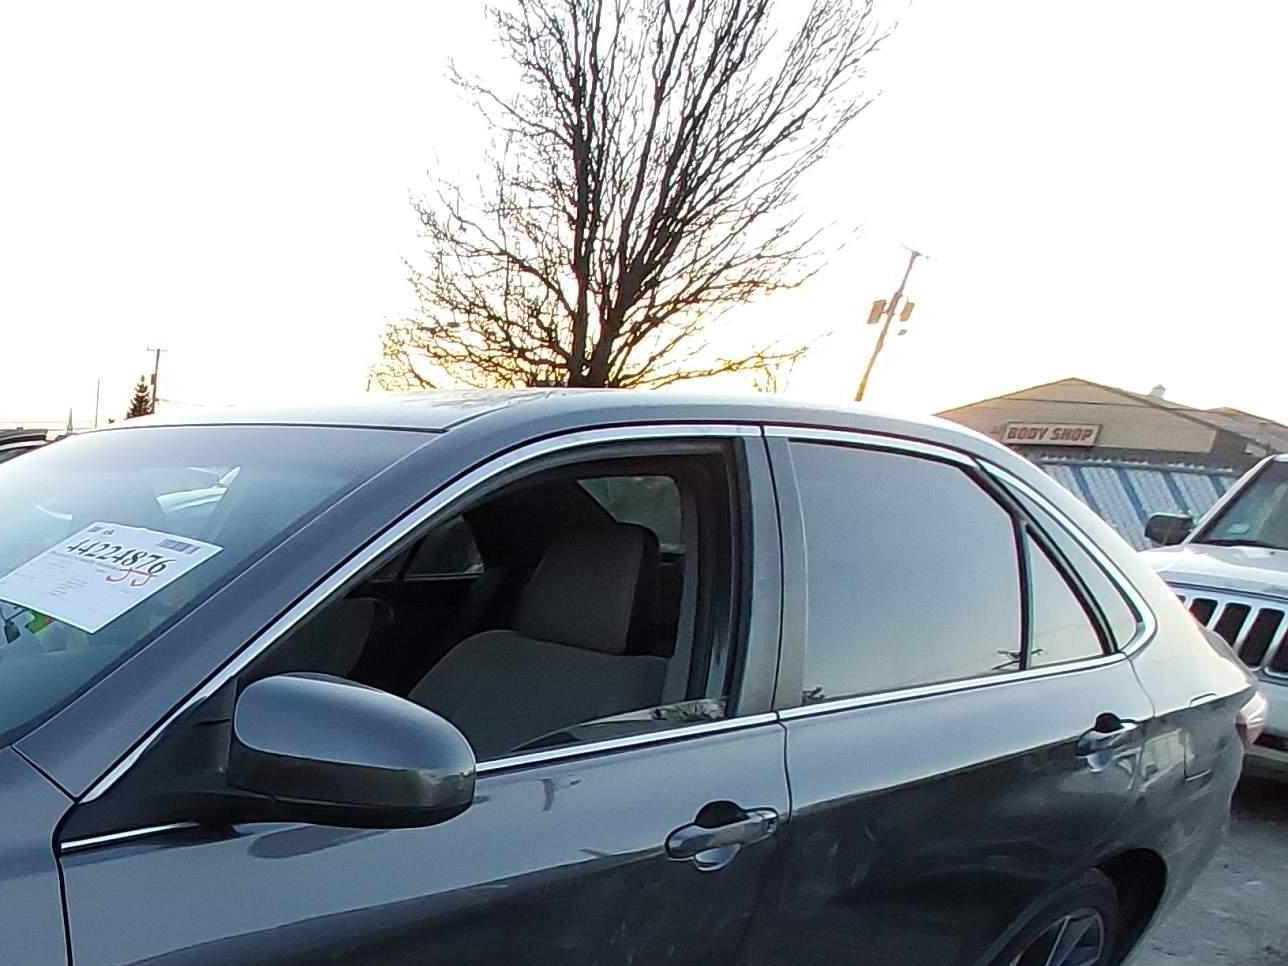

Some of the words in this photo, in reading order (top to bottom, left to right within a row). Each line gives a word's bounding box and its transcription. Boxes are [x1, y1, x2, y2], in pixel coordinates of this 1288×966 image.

[1007, 427, 1048, 440] BODY
[1050, 428, 1094, 441] SHOP
[67, 539, 176, 574] 44224876
